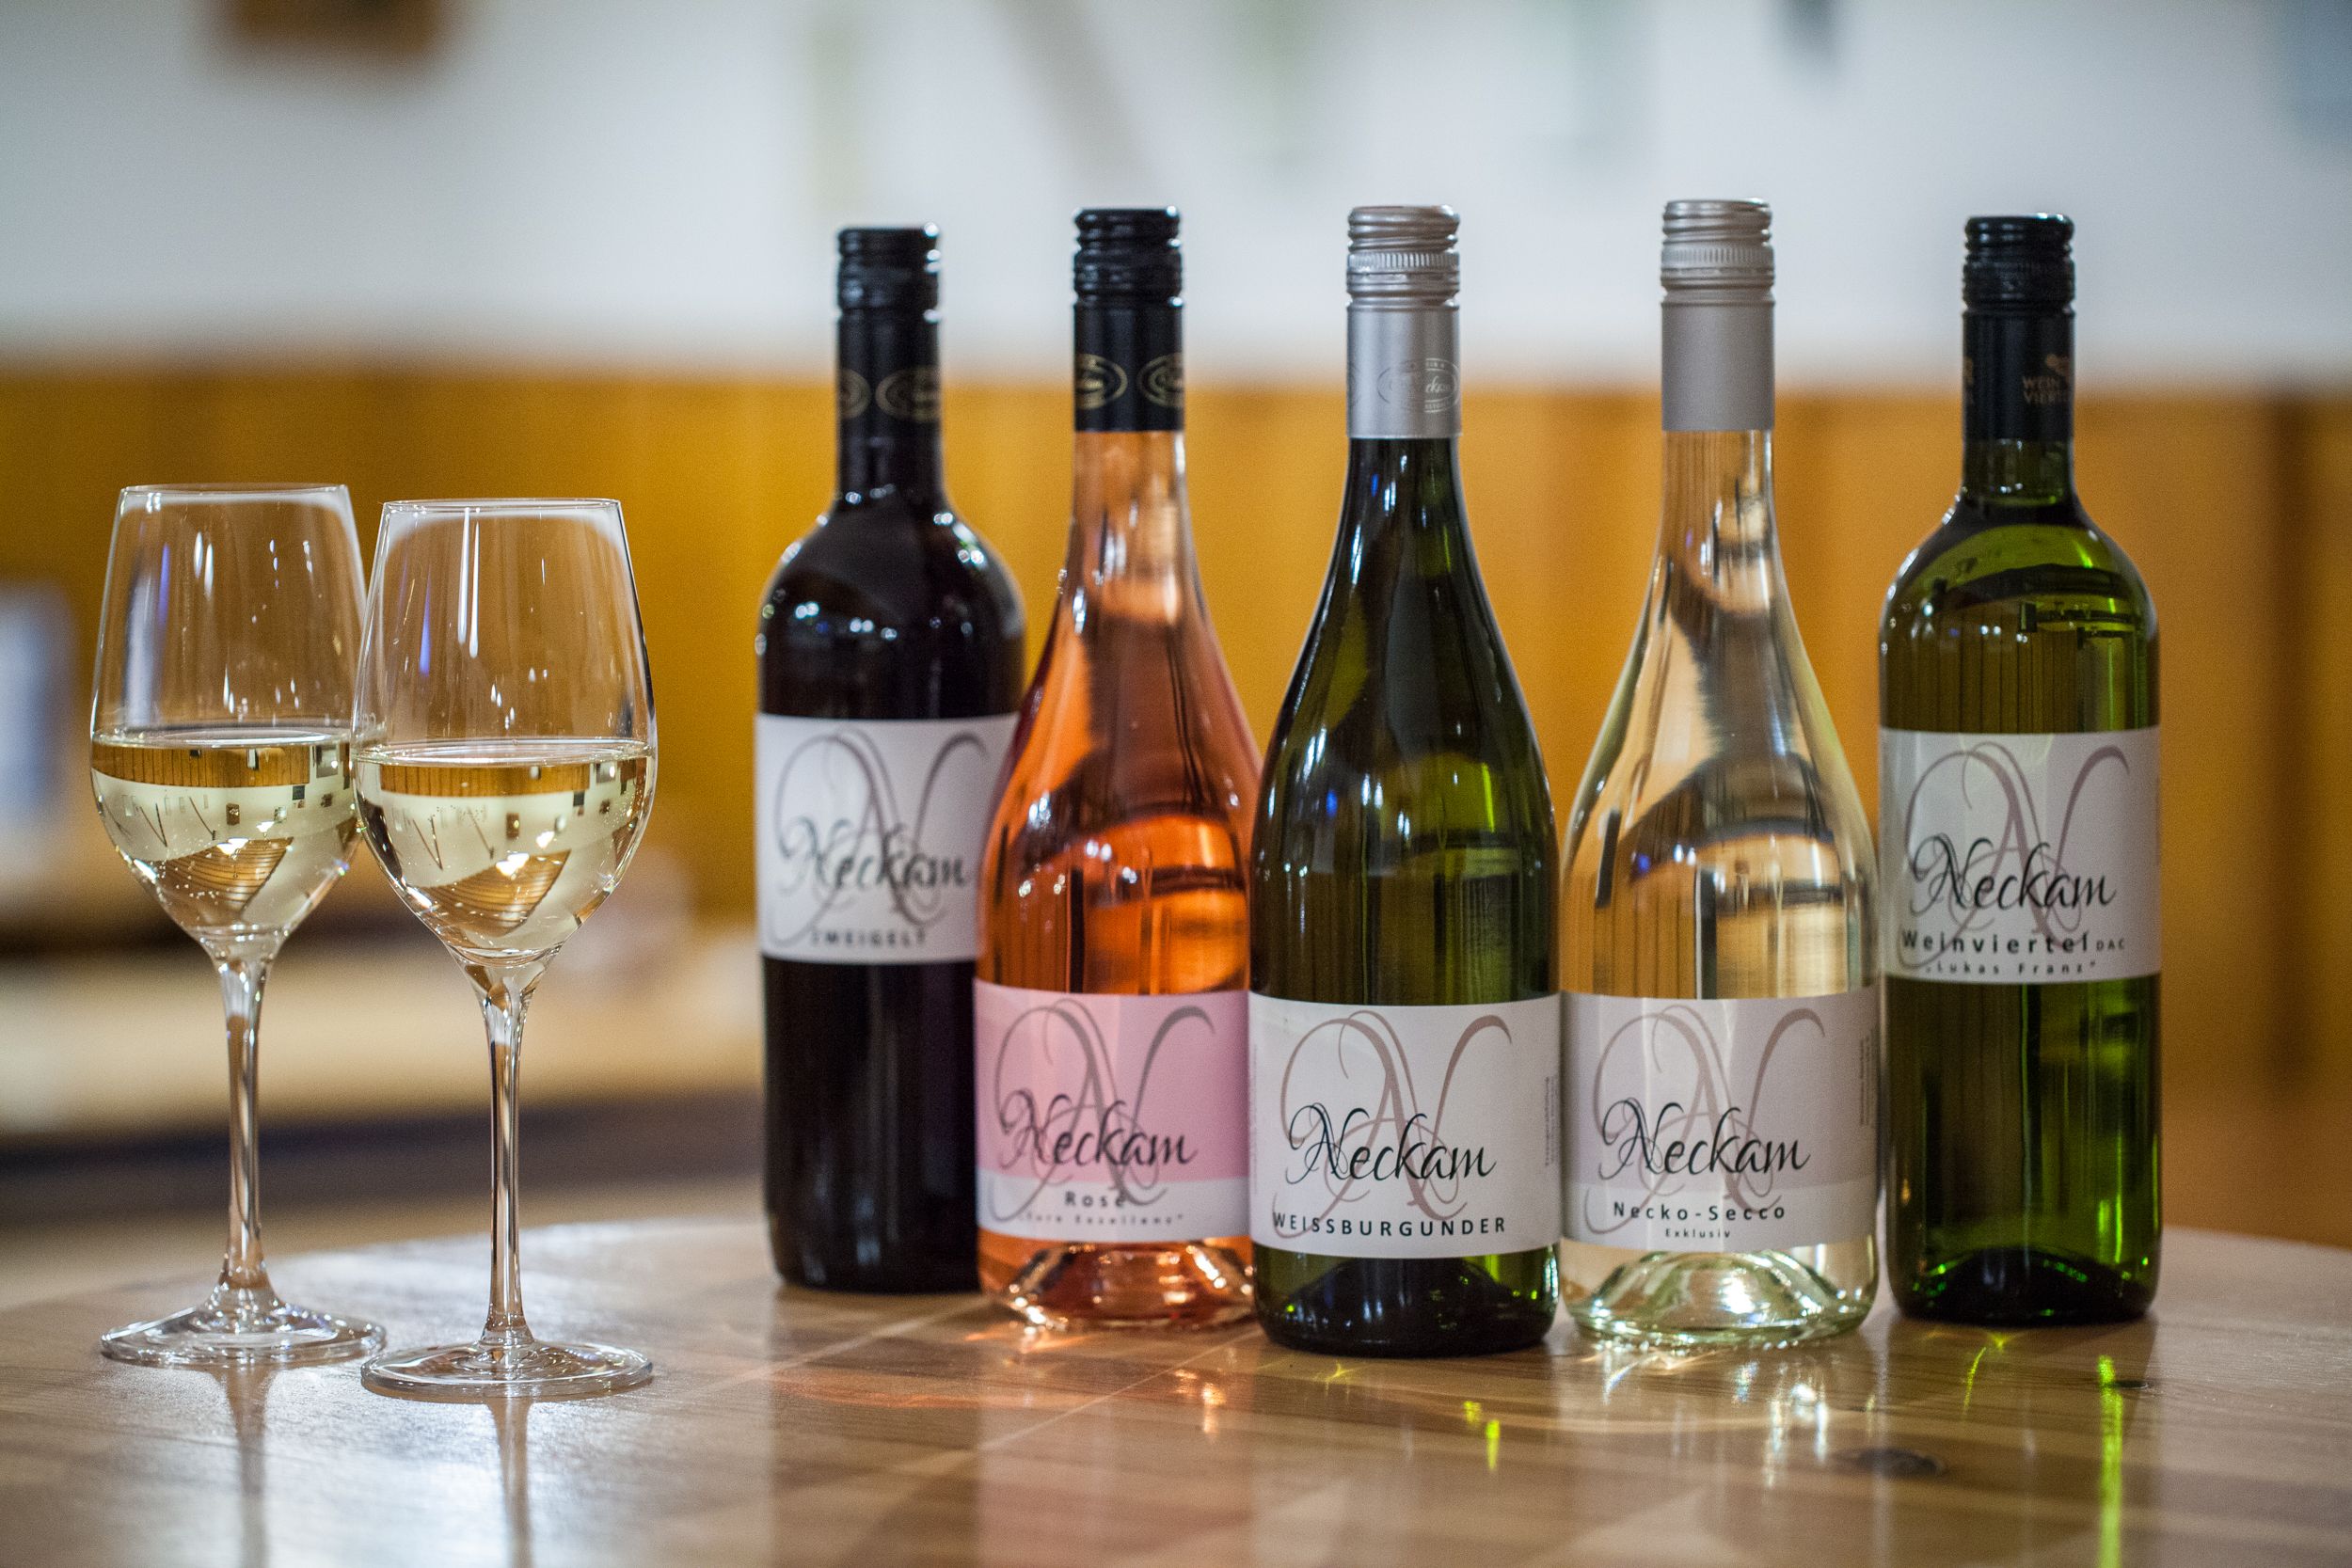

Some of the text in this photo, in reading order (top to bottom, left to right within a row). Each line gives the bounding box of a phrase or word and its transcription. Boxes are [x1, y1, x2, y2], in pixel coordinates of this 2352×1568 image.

[1910, 832, 2117, 917] Neckam
[1902, 928, 2090, 955] Weinviertel
[998, 1087, 1199, 1170] Neckam
[1285, 1102, 1498, 1185] Neckam
[1598, 1097, 1811, 1180] Neckam
[1272, 1211, 1505, 1237] WEISSBURGUNDER
[1613, 1201, 1786, 1221] Necko-Secco
[1665, 1227, 1732, 1239] Exklusiv
